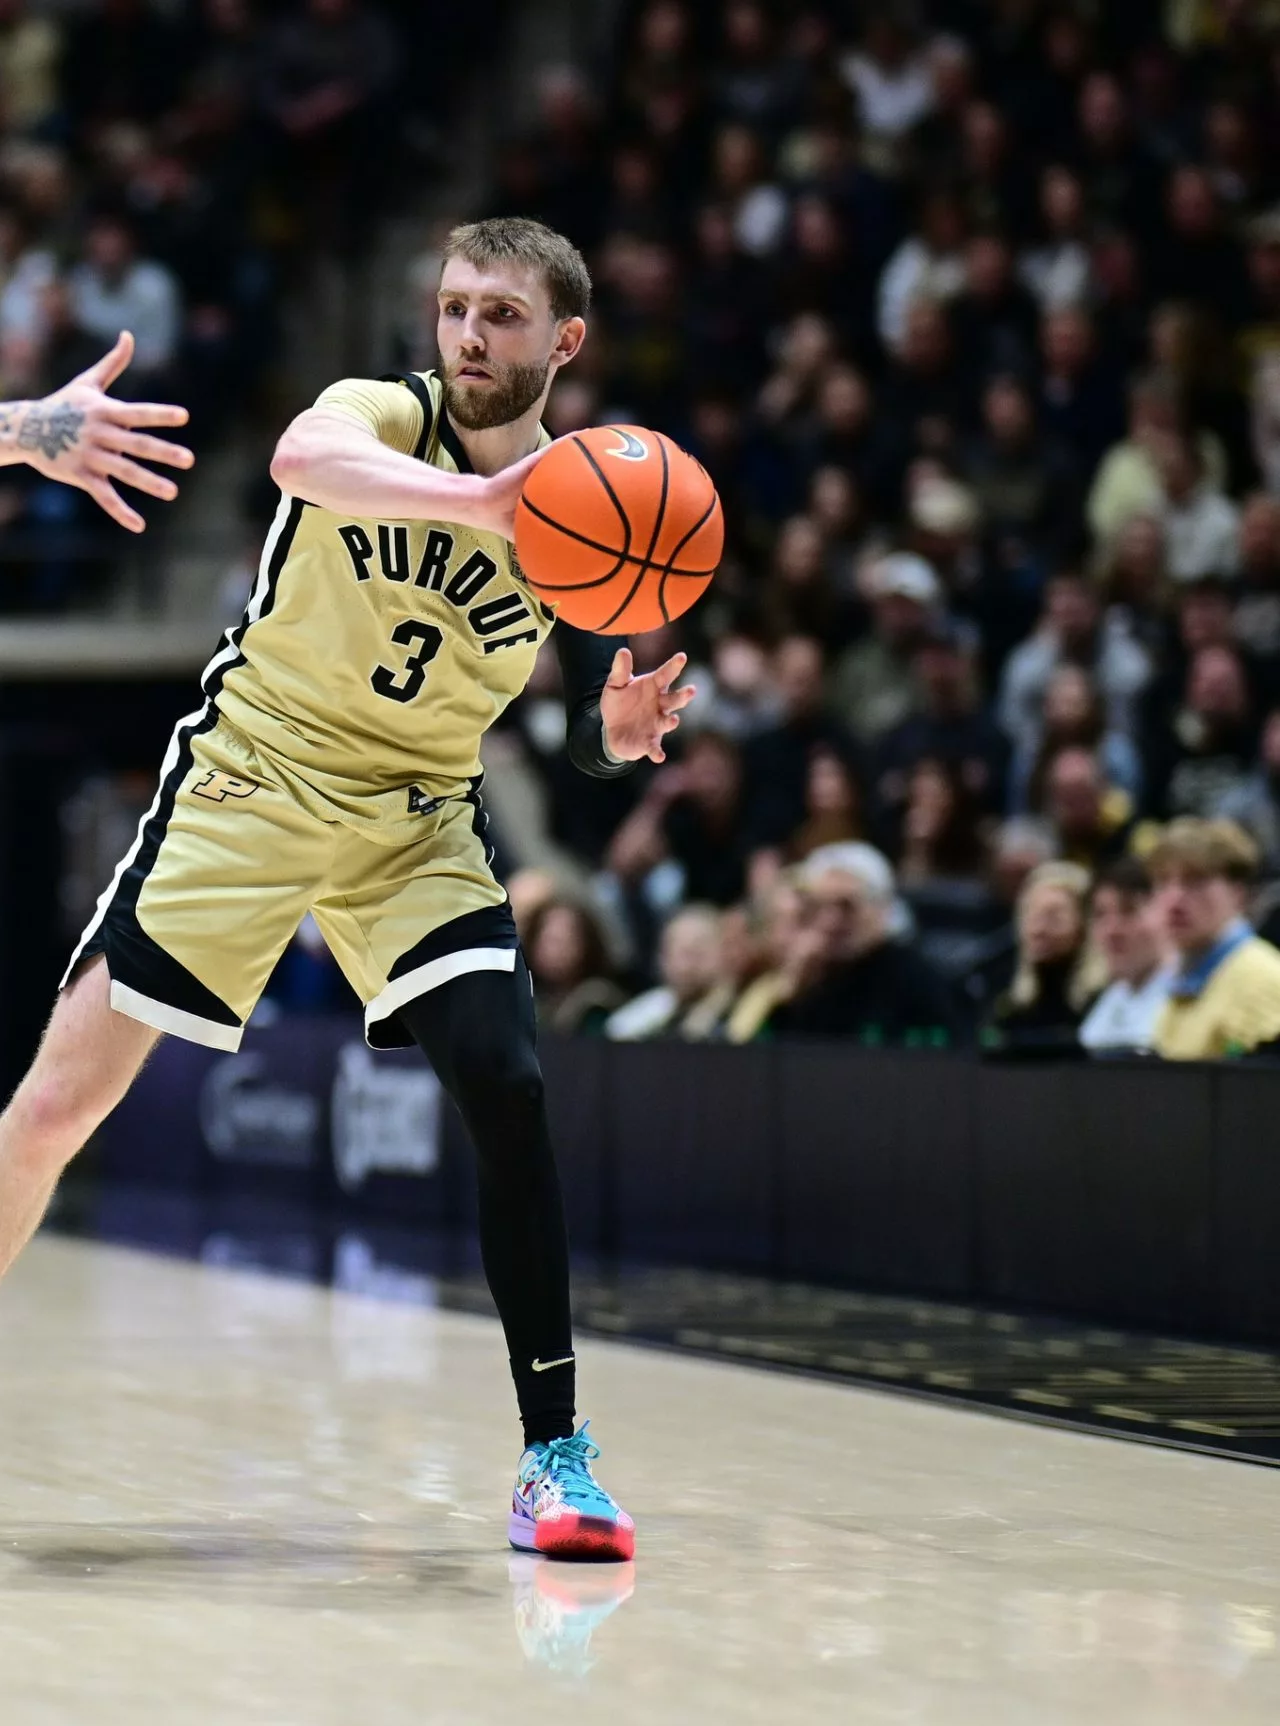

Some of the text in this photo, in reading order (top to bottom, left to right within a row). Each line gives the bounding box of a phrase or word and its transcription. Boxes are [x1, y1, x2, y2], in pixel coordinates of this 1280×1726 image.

[337, 524, 538, 654] PURDUE
[370, 619, 444, 703] 3
[190, 768, 260, 803] P
